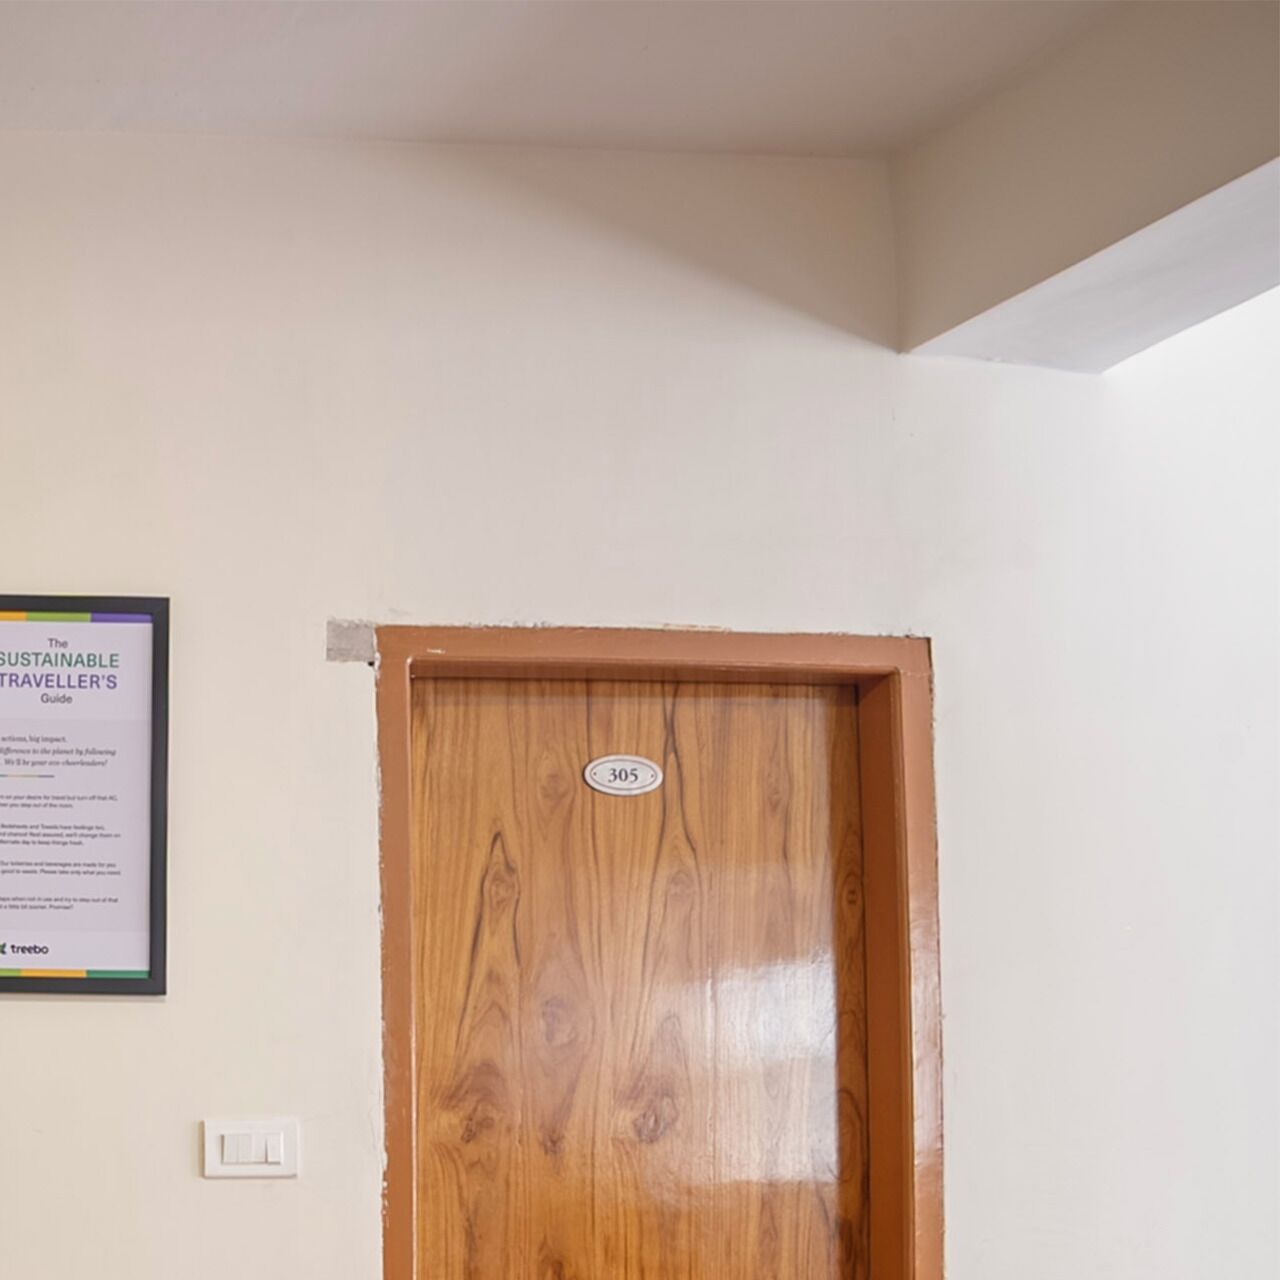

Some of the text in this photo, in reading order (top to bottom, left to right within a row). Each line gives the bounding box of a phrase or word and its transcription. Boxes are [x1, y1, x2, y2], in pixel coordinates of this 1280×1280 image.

[48, 638, 68, 648] The
[40, 693, 72, 703] Guide
[608, 768, 638, 783] 305
[11, 944, 49, 955] treebo
